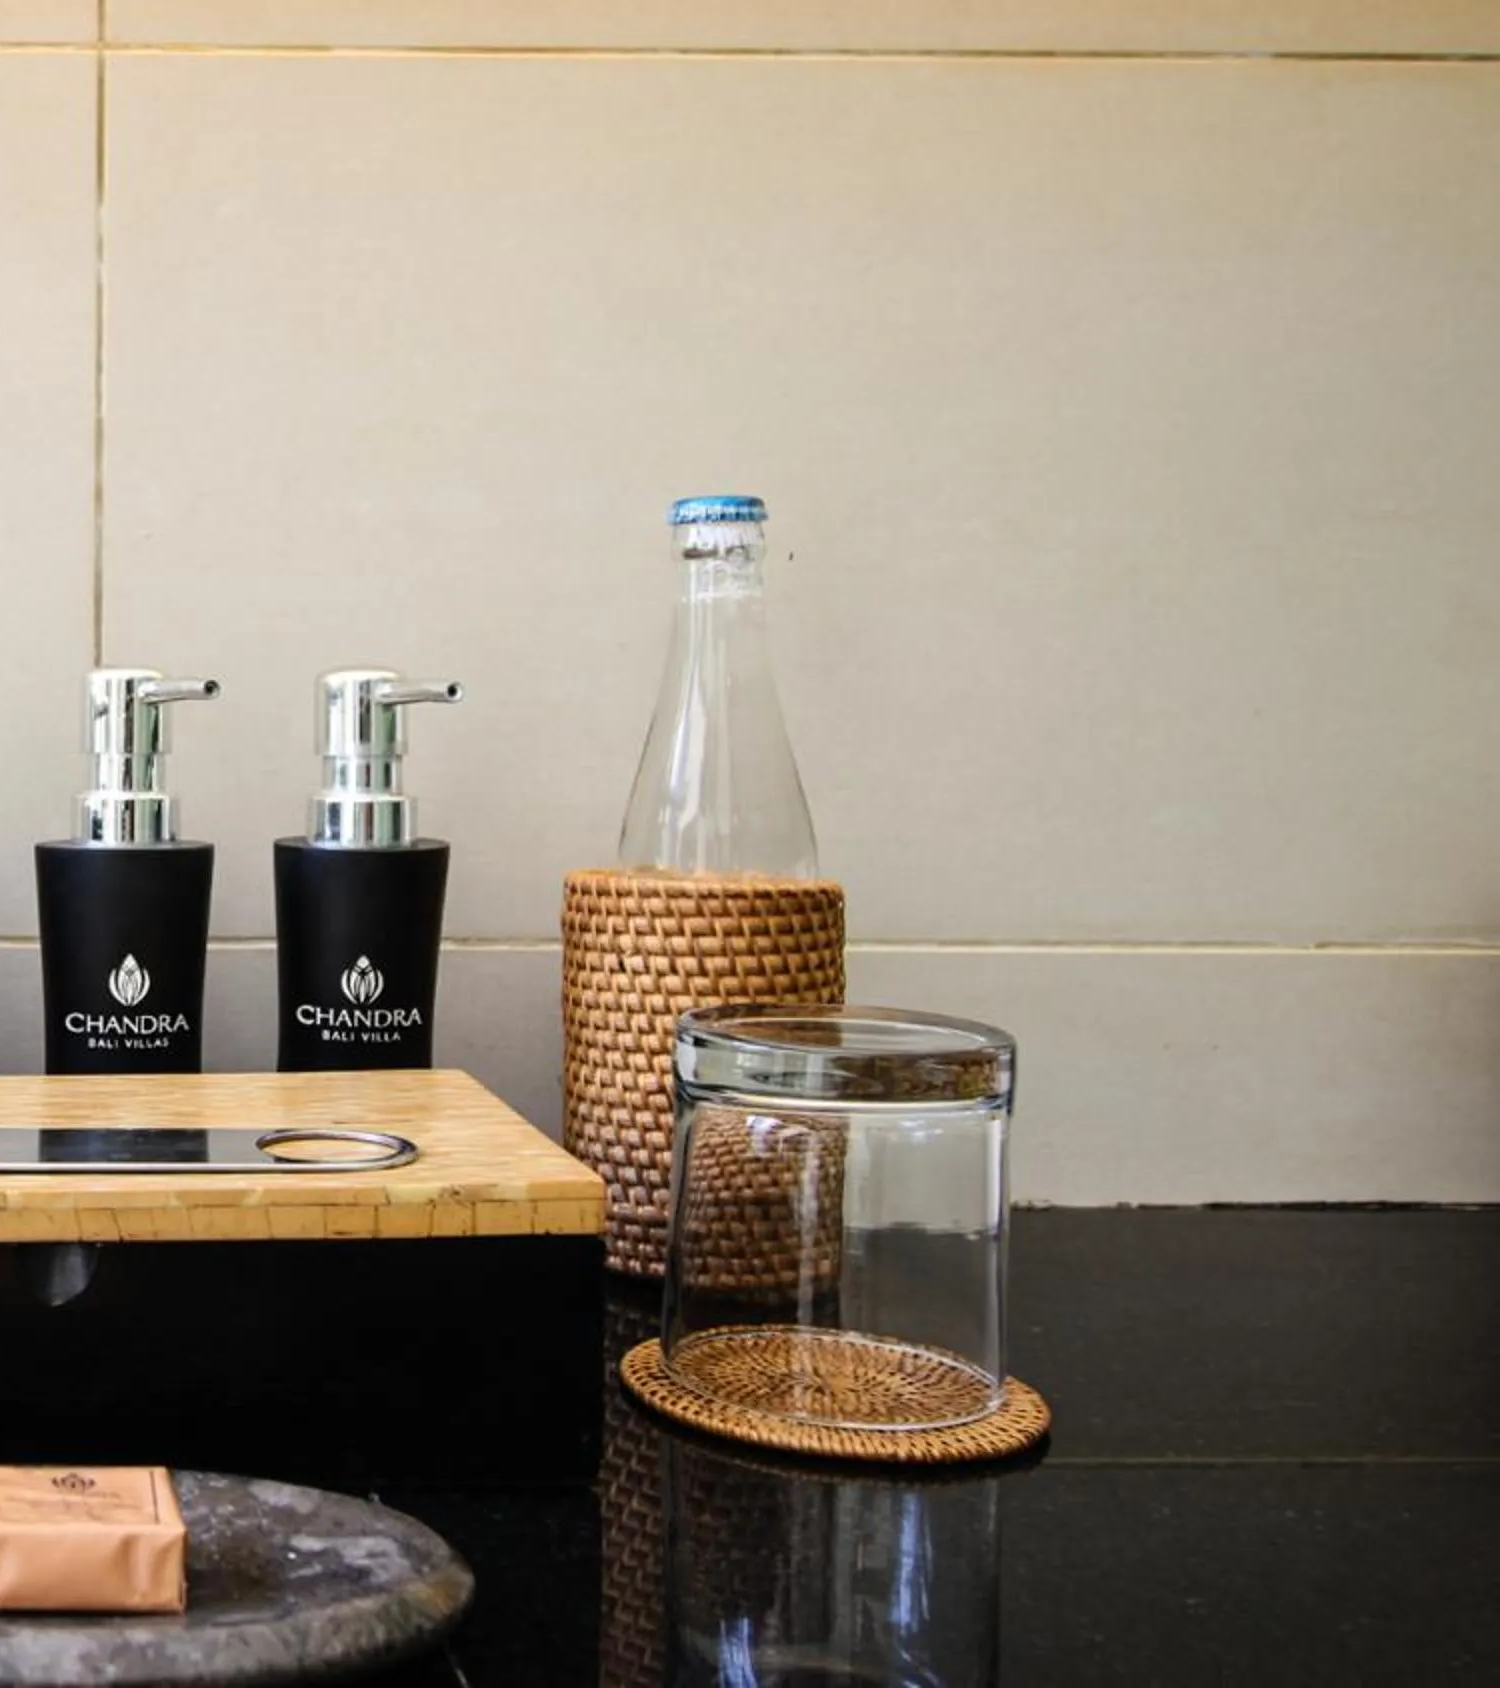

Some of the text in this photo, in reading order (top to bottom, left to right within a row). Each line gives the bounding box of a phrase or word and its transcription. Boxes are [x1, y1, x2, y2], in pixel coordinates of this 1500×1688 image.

[65, 1012, 190, 1035] CHANDRA
[295, 1004, 422, 1028] CHANDRA
[87, 1037, 169, 1049] BALI VILLAS
[321, 1029, 355, 1041] BALI
